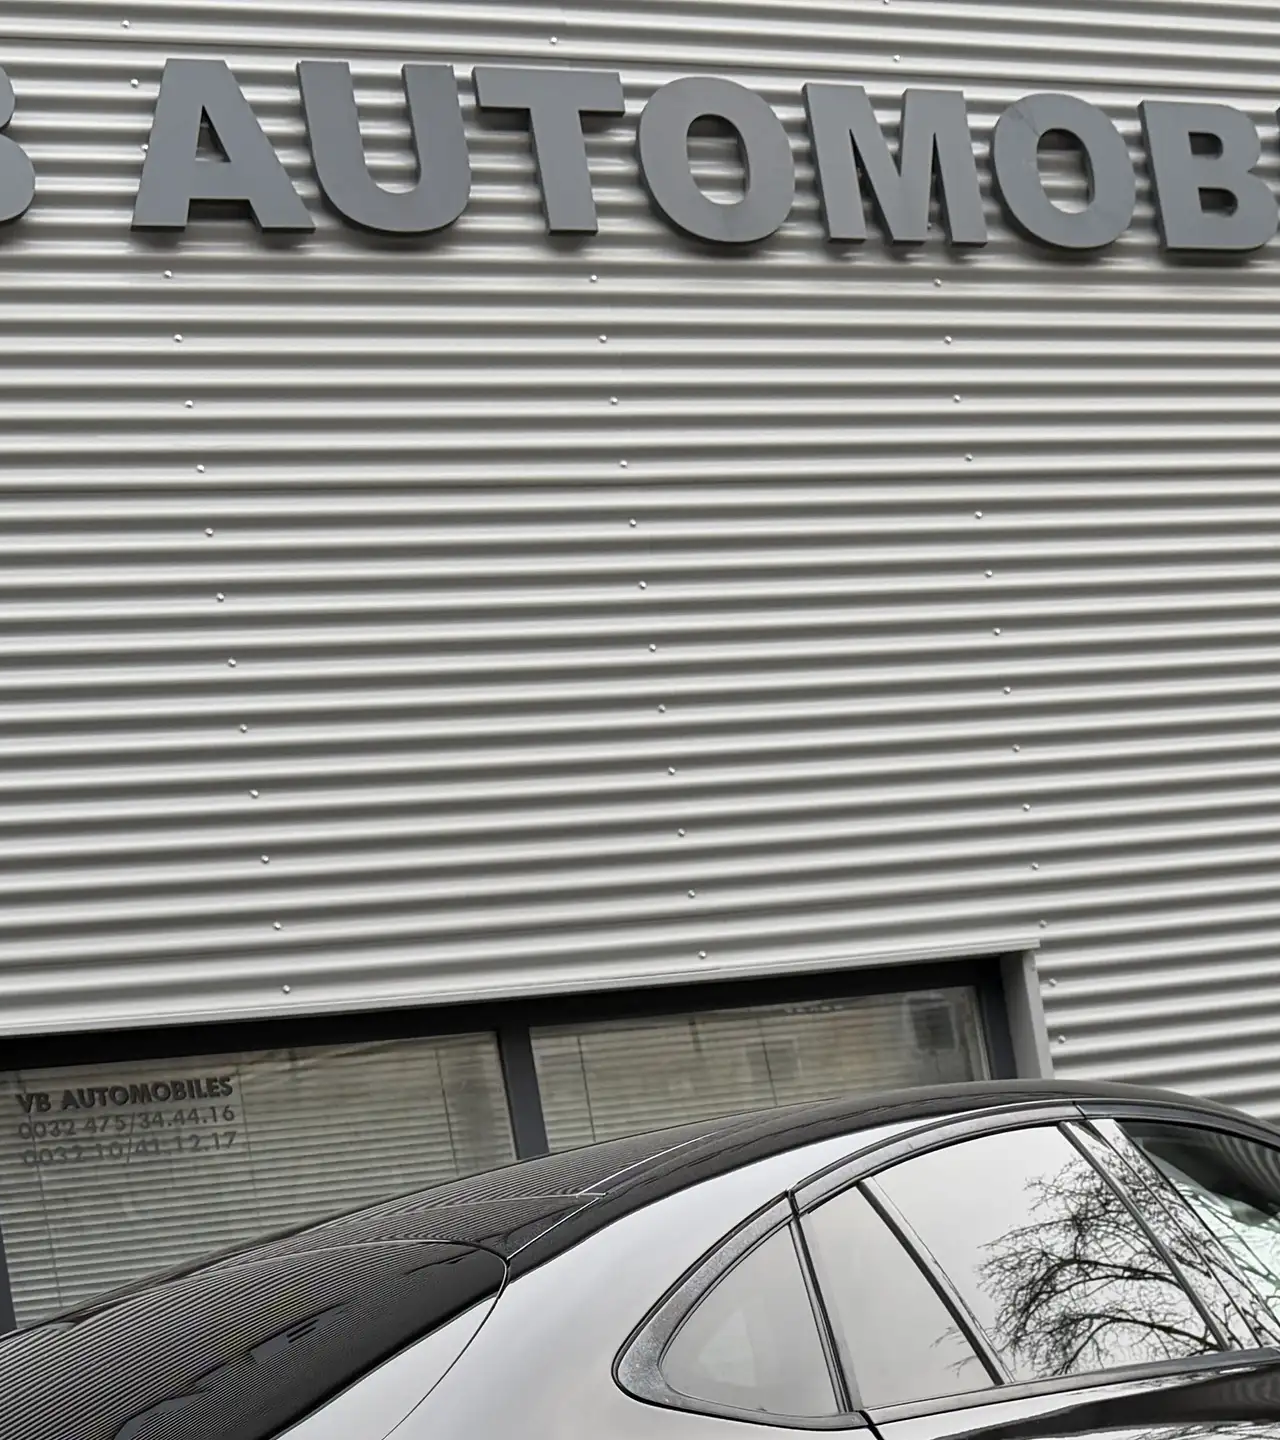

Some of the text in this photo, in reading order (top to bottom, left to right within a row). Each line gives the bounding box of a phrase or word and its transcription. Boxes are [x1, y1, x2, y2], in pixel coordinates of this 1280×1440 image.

[16, 1077, 233, 1114] VB AUTOMOBILES
[18, 1105, 236, 1140] 0032 475/34.44.16
[23, 1131, 238, 1168] 0032 10/41.12.17
